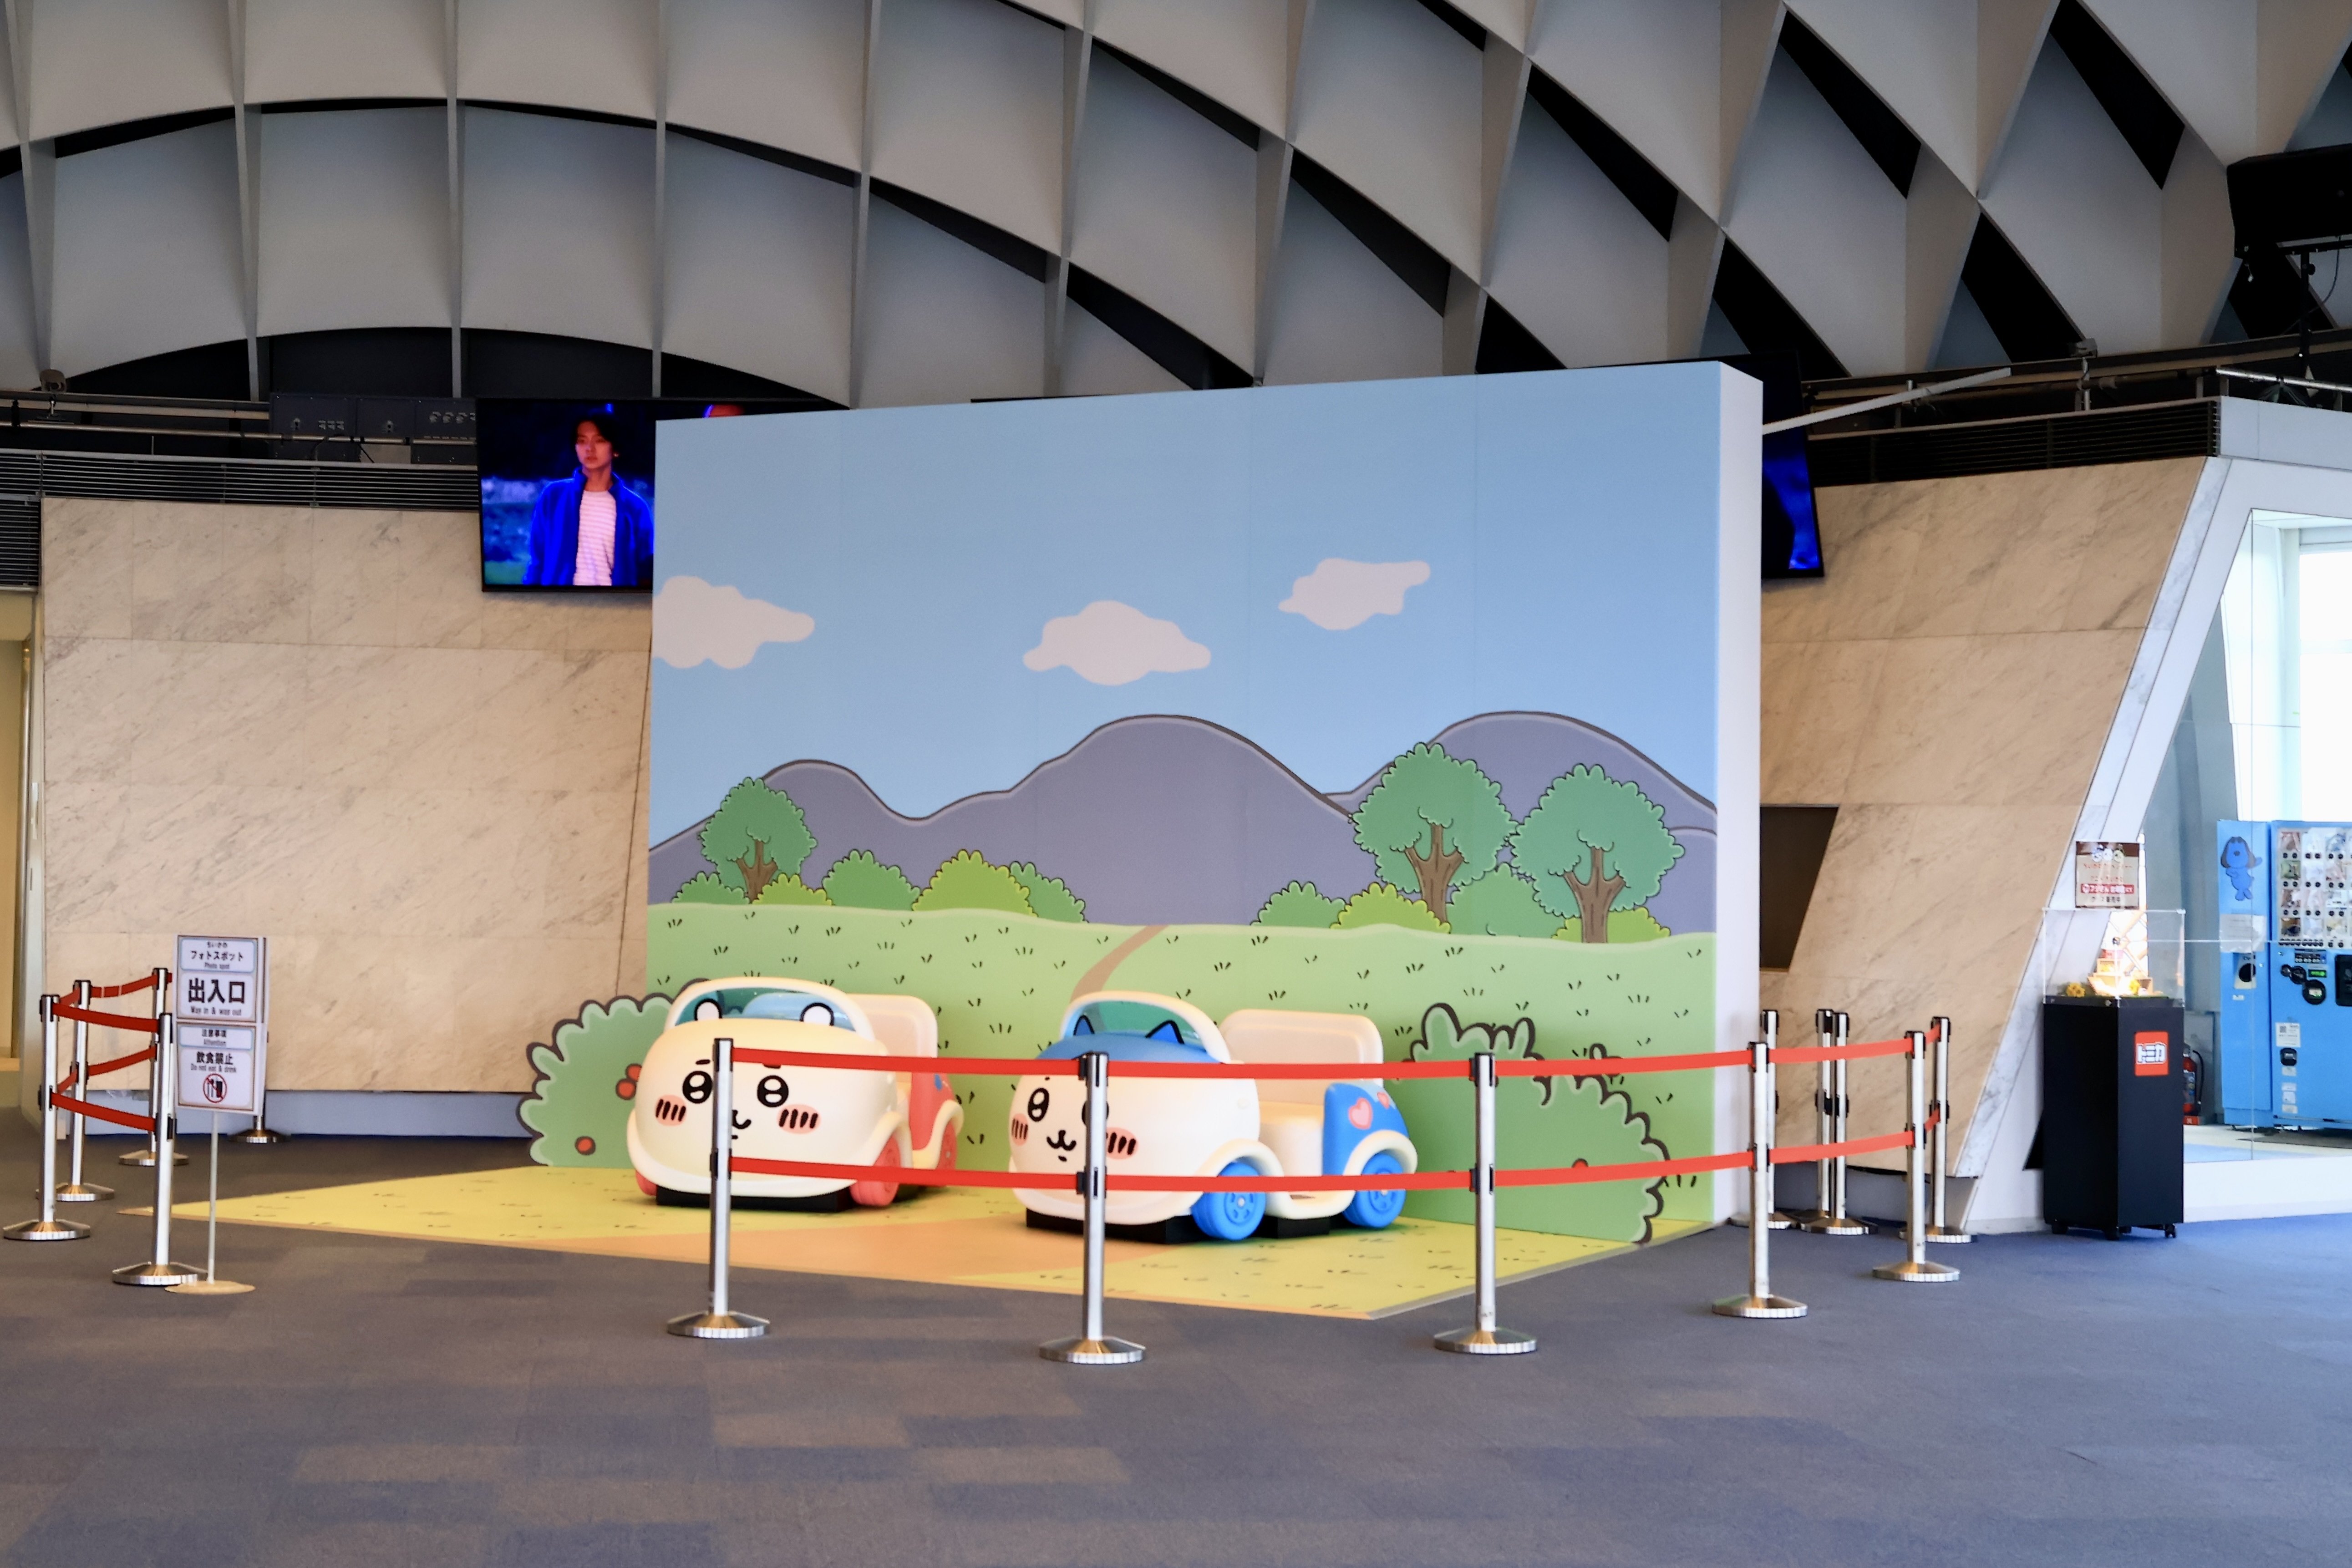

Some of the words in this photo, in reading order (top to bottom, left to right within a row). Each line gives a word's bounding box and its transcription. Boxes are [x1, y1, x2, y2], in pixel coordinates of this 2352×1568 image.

[190, 950, 244, 961] フォトスポット
[188, 978, 245, 1004] 出入口
[202, 1029, 226, 1037] 注意事項
[197, 1051, 234, 1065] 飲食禁止
[2136, 1041, 2167, 1065] トミカ
